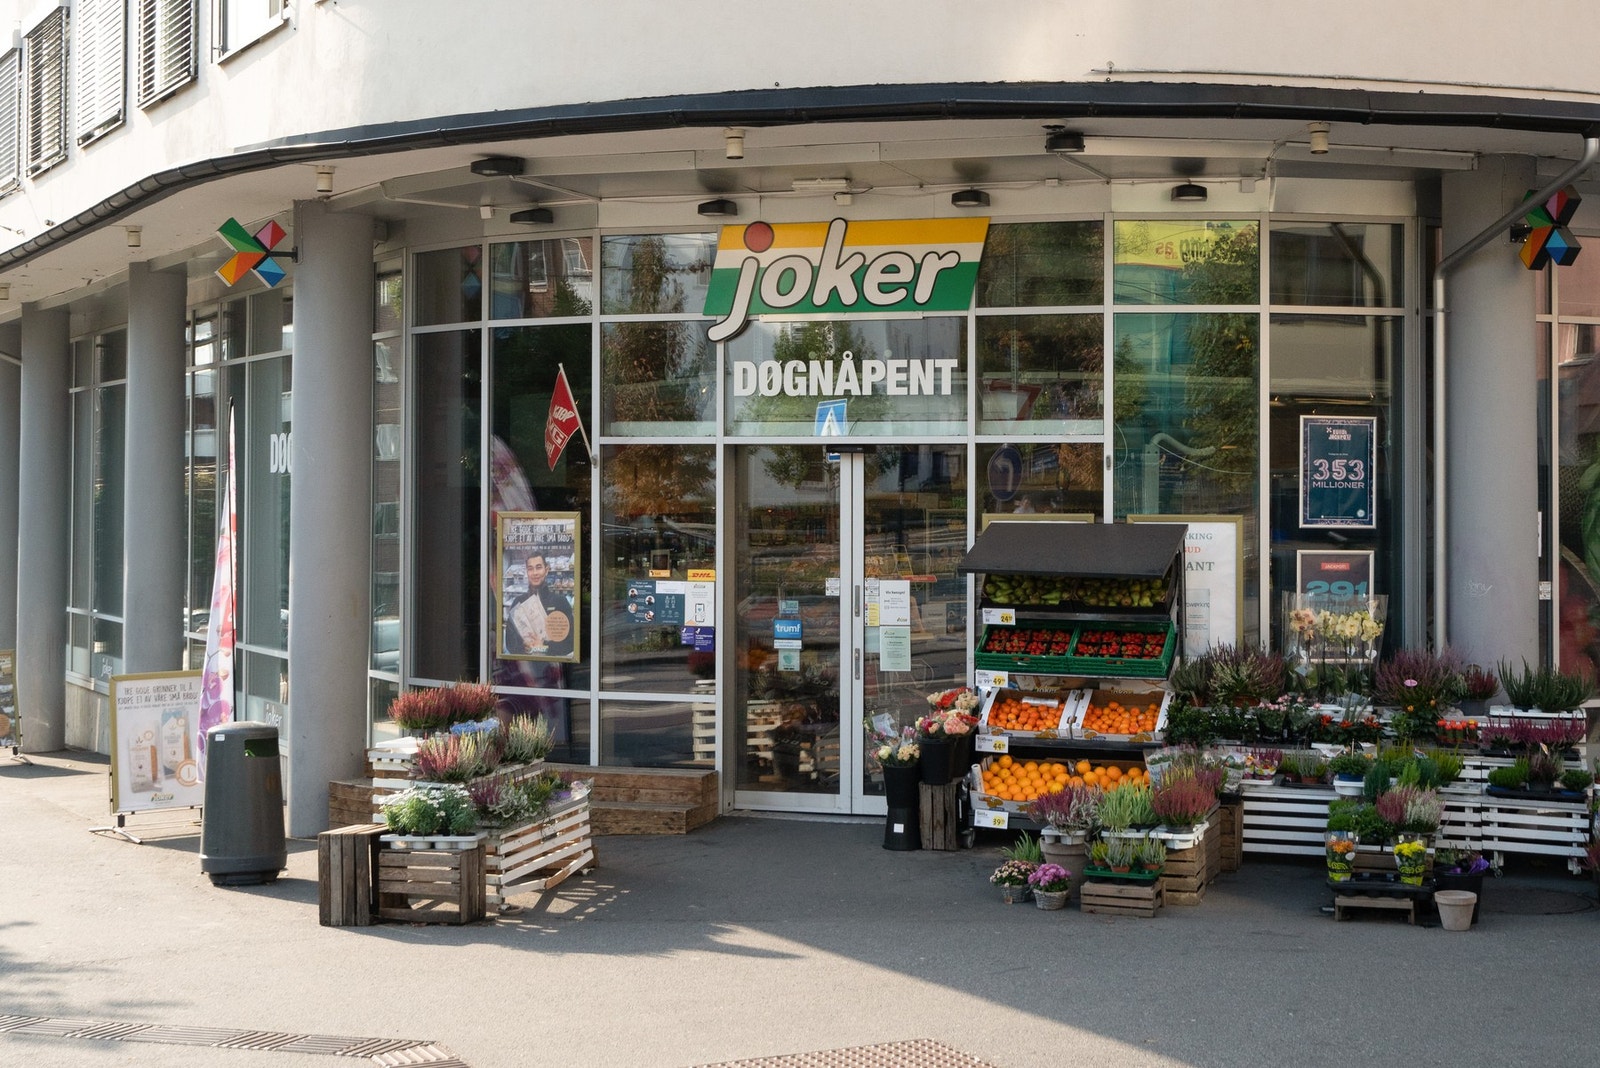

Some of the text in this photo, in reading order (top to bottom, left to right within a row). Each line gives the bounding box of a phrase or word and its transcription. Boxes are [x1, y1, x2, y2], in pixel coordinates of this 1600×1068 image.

[707, 217, 961, 342] joker
[733, 350, 958, 398] DØGNÅPENT
[1313, 459, 1365, 481] 353
[1312, 481, 1365, 489] MILLIONER
[1185, 532, 1213, 540] KING
[1306, 580, 1368, 602] 291
[775, 623, 801, 633] trumf
